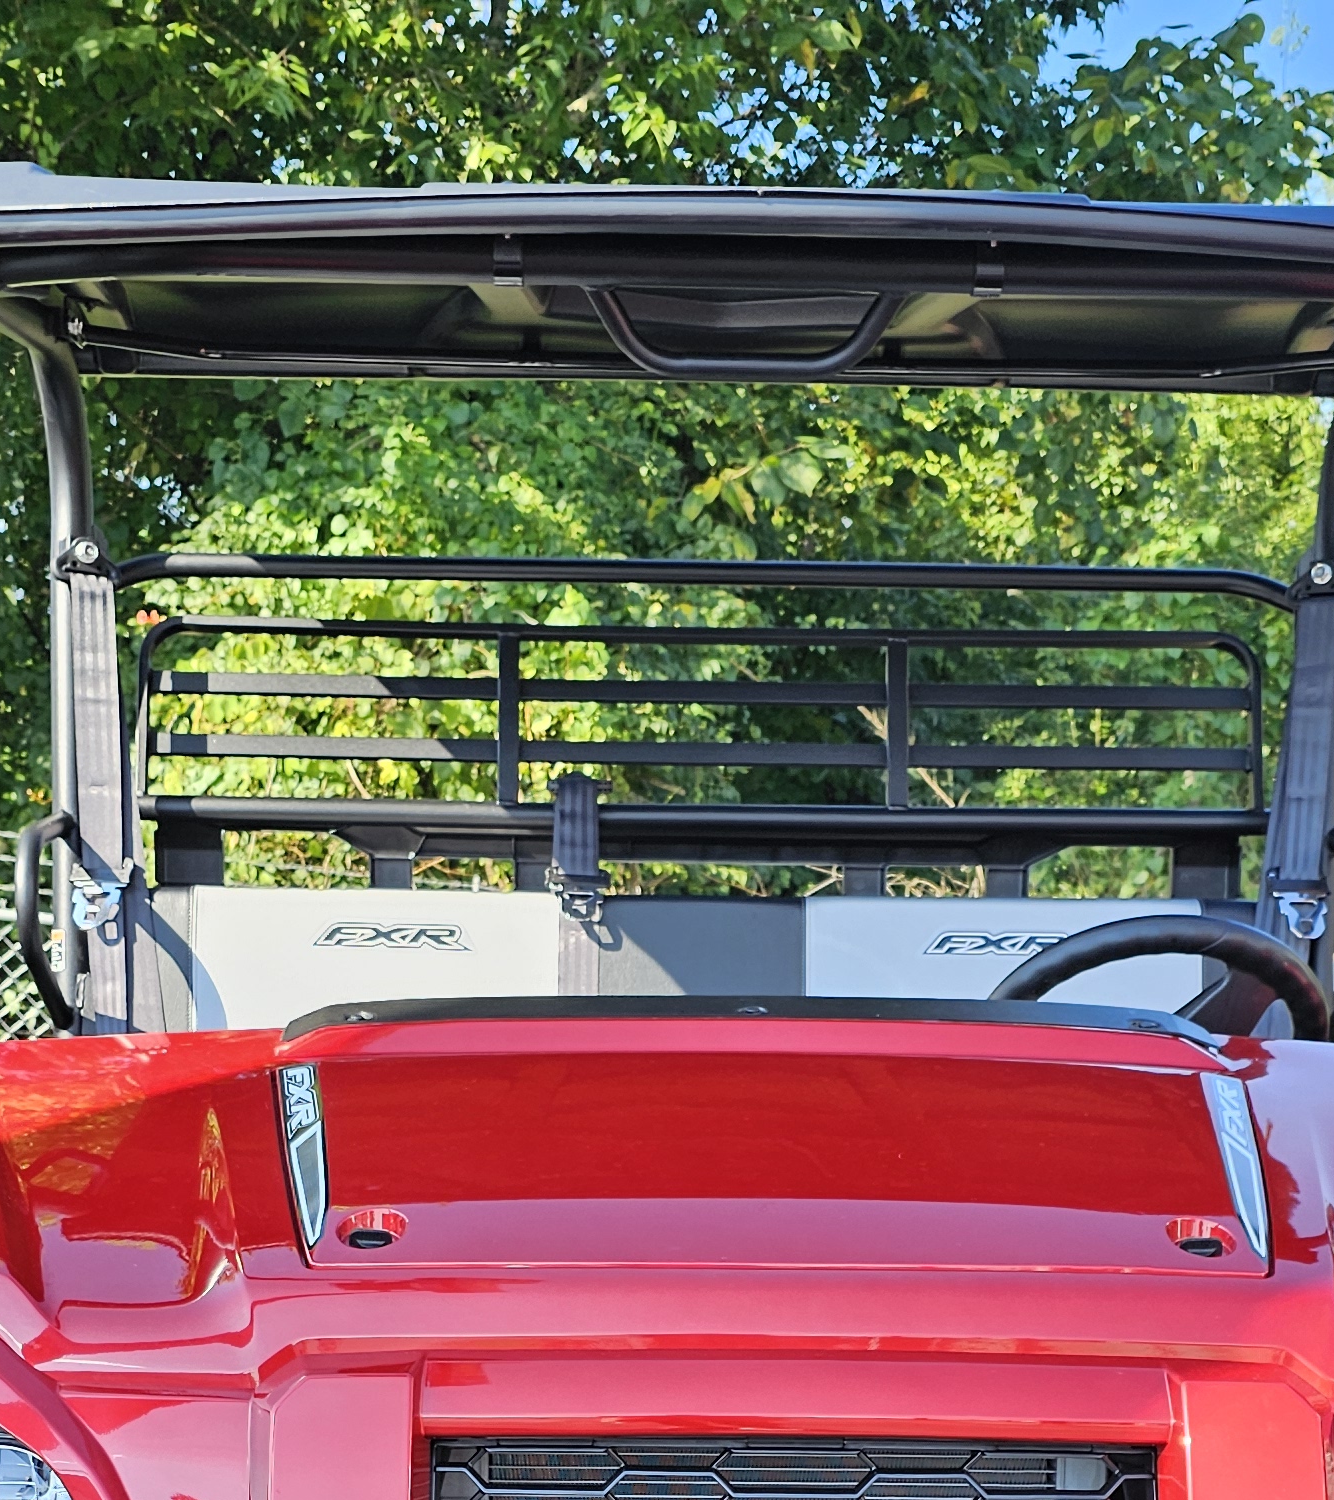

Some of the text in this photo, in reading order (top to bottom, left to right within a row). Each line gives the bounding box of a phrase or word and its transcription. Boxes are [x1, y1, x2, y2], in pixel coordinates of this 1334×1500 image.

[314, 920, 474, 952] FXR
[283, 1065, 320, 1141] FXR
[1216, 1079, 1248, 1148] FXR
